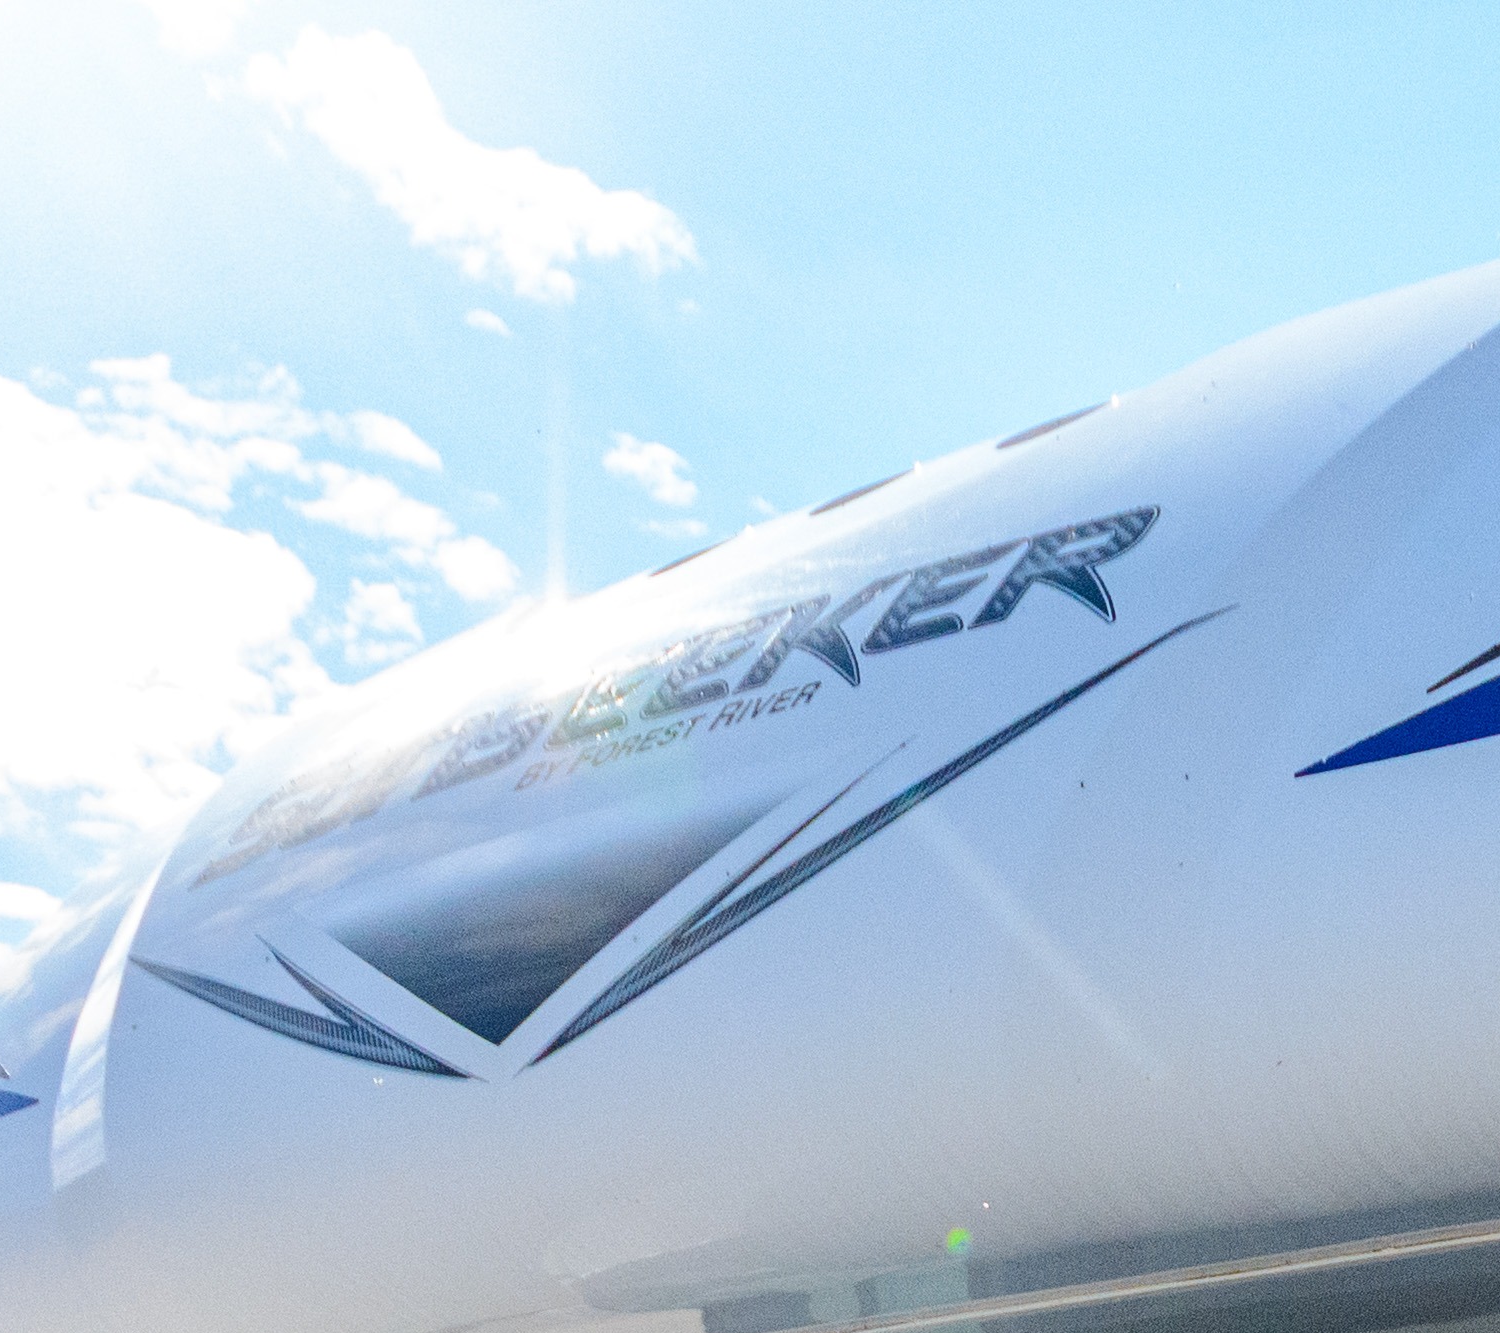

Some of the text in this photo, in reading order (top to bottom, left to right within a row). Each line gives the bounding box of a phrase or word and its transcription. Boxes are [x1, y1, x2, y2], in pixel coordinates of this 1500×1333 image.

[187, 505, 1161, 891] SUSEEKER
[567, 713, 707, 774] FOREST
[708, 680, 823, 732] RIVER
